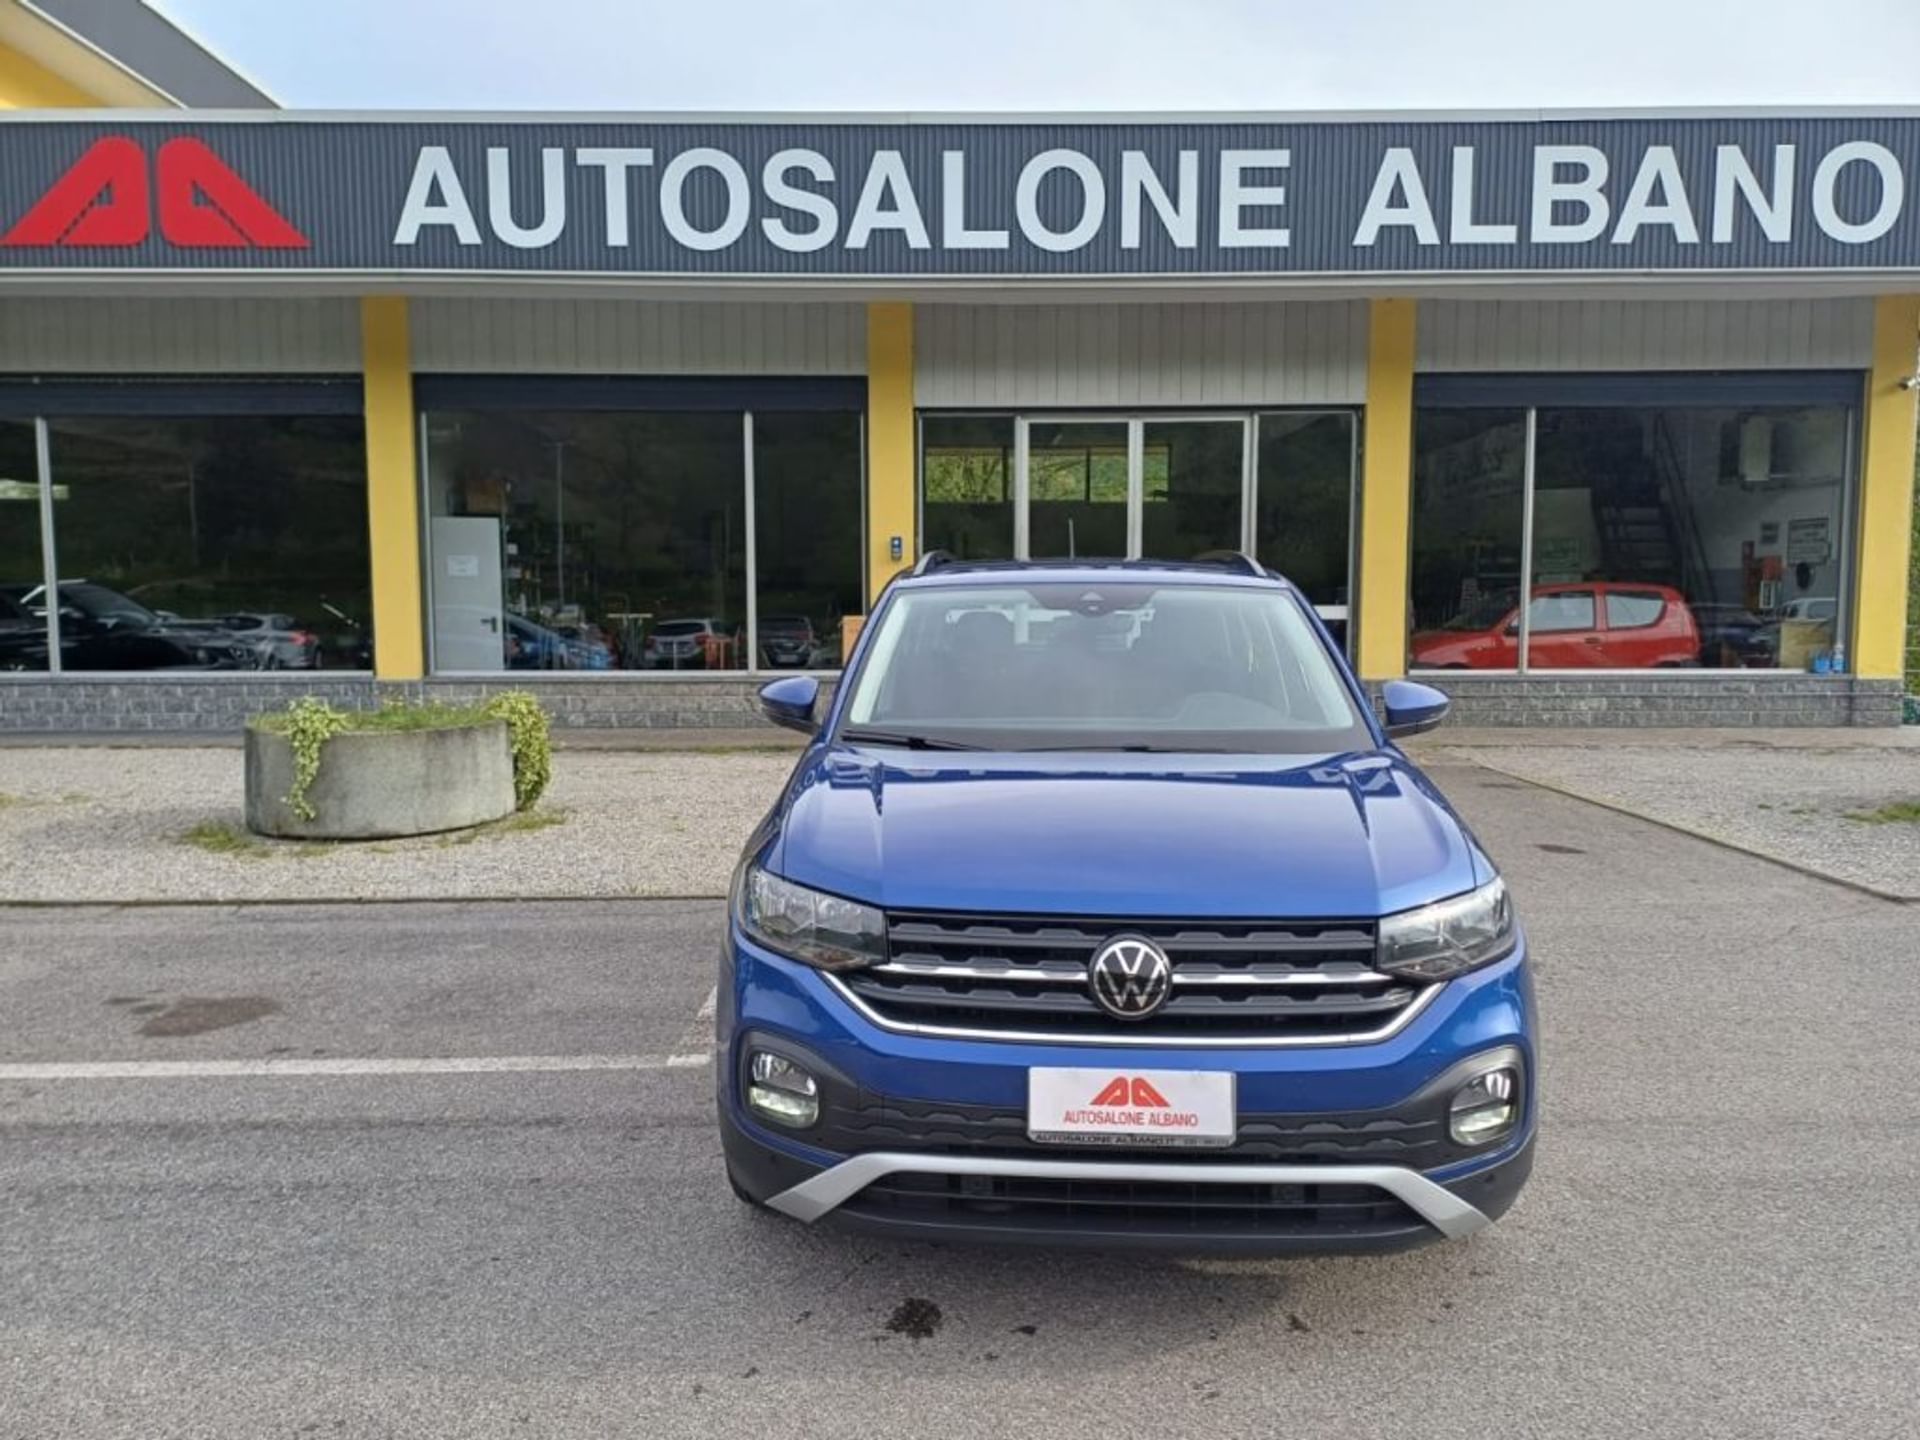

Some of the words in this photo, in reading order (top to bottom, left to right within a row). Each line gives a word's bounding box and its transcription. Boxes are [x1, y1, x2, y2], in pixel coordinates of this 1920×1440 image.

[393, 145, 1291, 254] AUTOSALONE
[1352, 140, 1905, 247] ALBANO
[1063, 1109, 1145, 1126] AUTOSALONE
[1148, 1112, 1198, 1127] ALBANO
